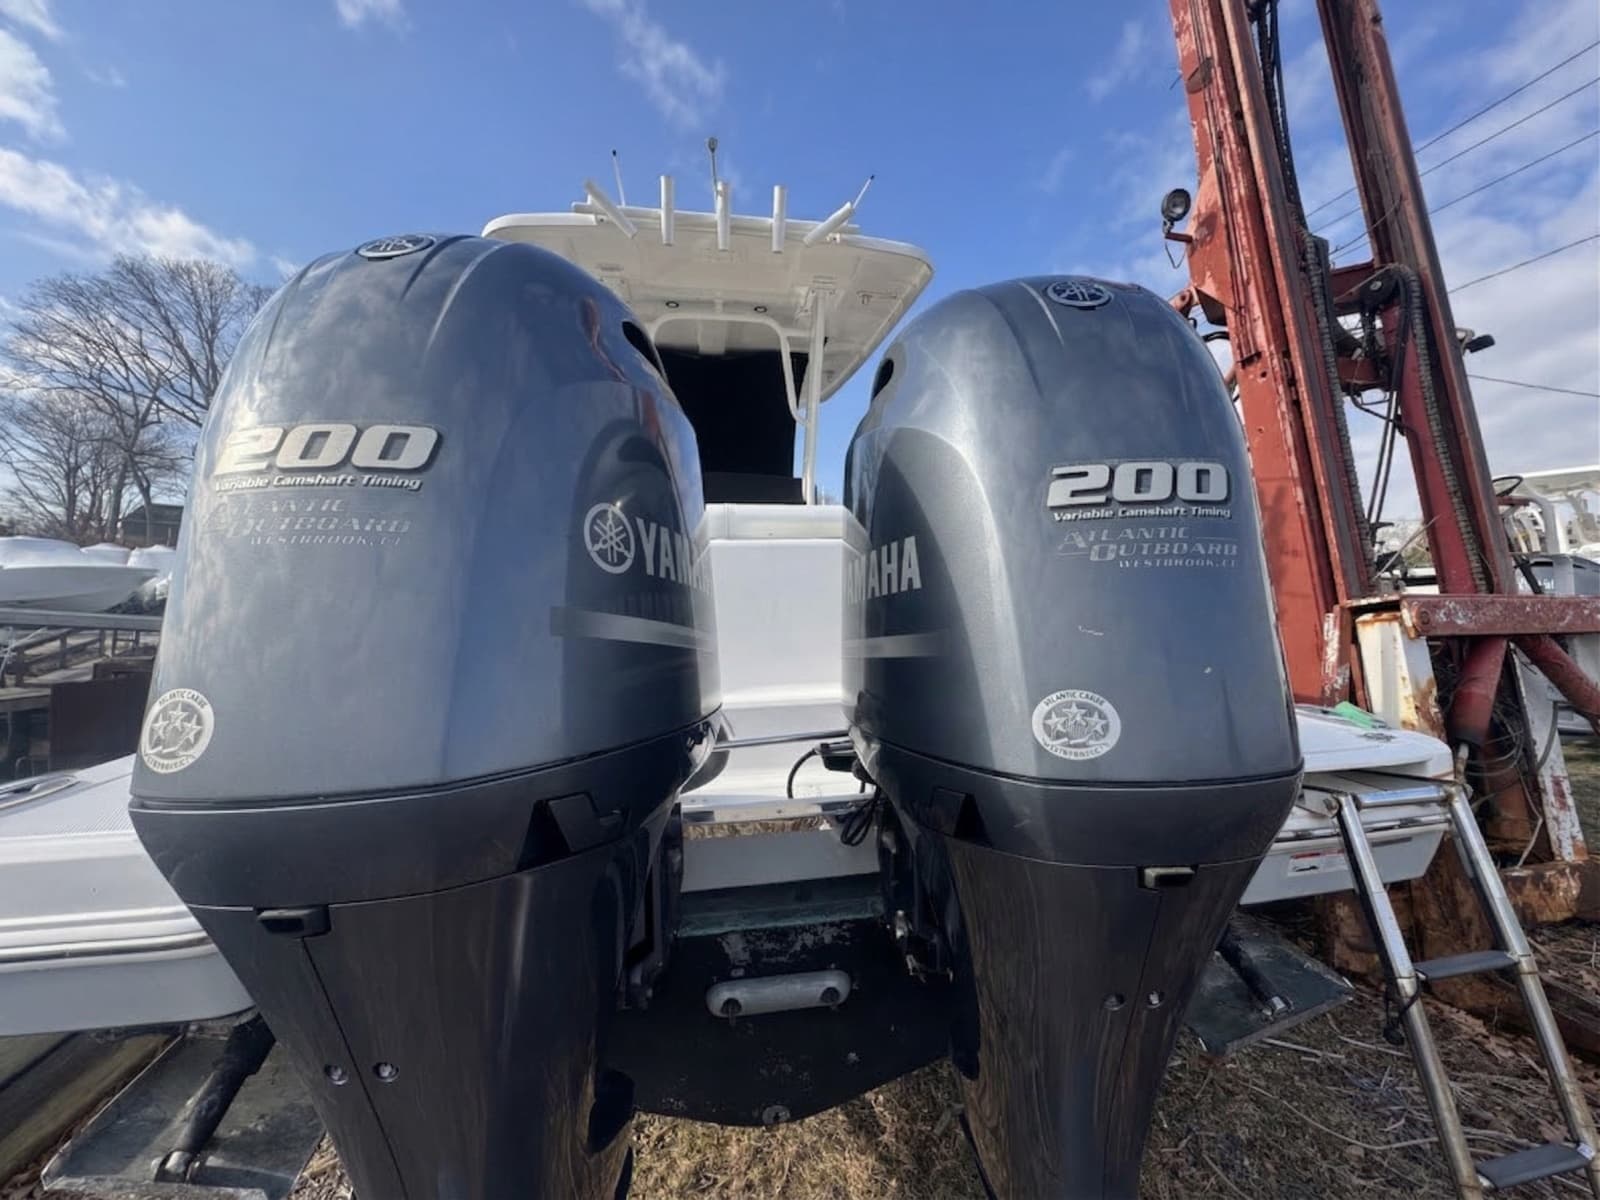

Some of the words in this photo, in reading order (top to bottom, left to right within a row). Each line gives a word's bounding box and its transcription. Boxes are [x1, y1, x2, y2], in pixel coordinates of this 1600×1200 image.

[213, 423, 441, 476] 200
[215, 475, 271, 492] Variable
[272, 474, 356, 487] Camshaft
[361, 474, 423, 492] Timing
[1047, 461, 1230, 507] 200
[1053, 507, 1114, 522] Variable
[1117, 506, 1187, 519] Camshaft
[1191, 506, 1232, 519] Timing
[1057, 526, 1190, 550] ATLANTIC
[1089, 542, 1239, 562] OUTBOARD
[845, 535, 922, 605] AMAHA
